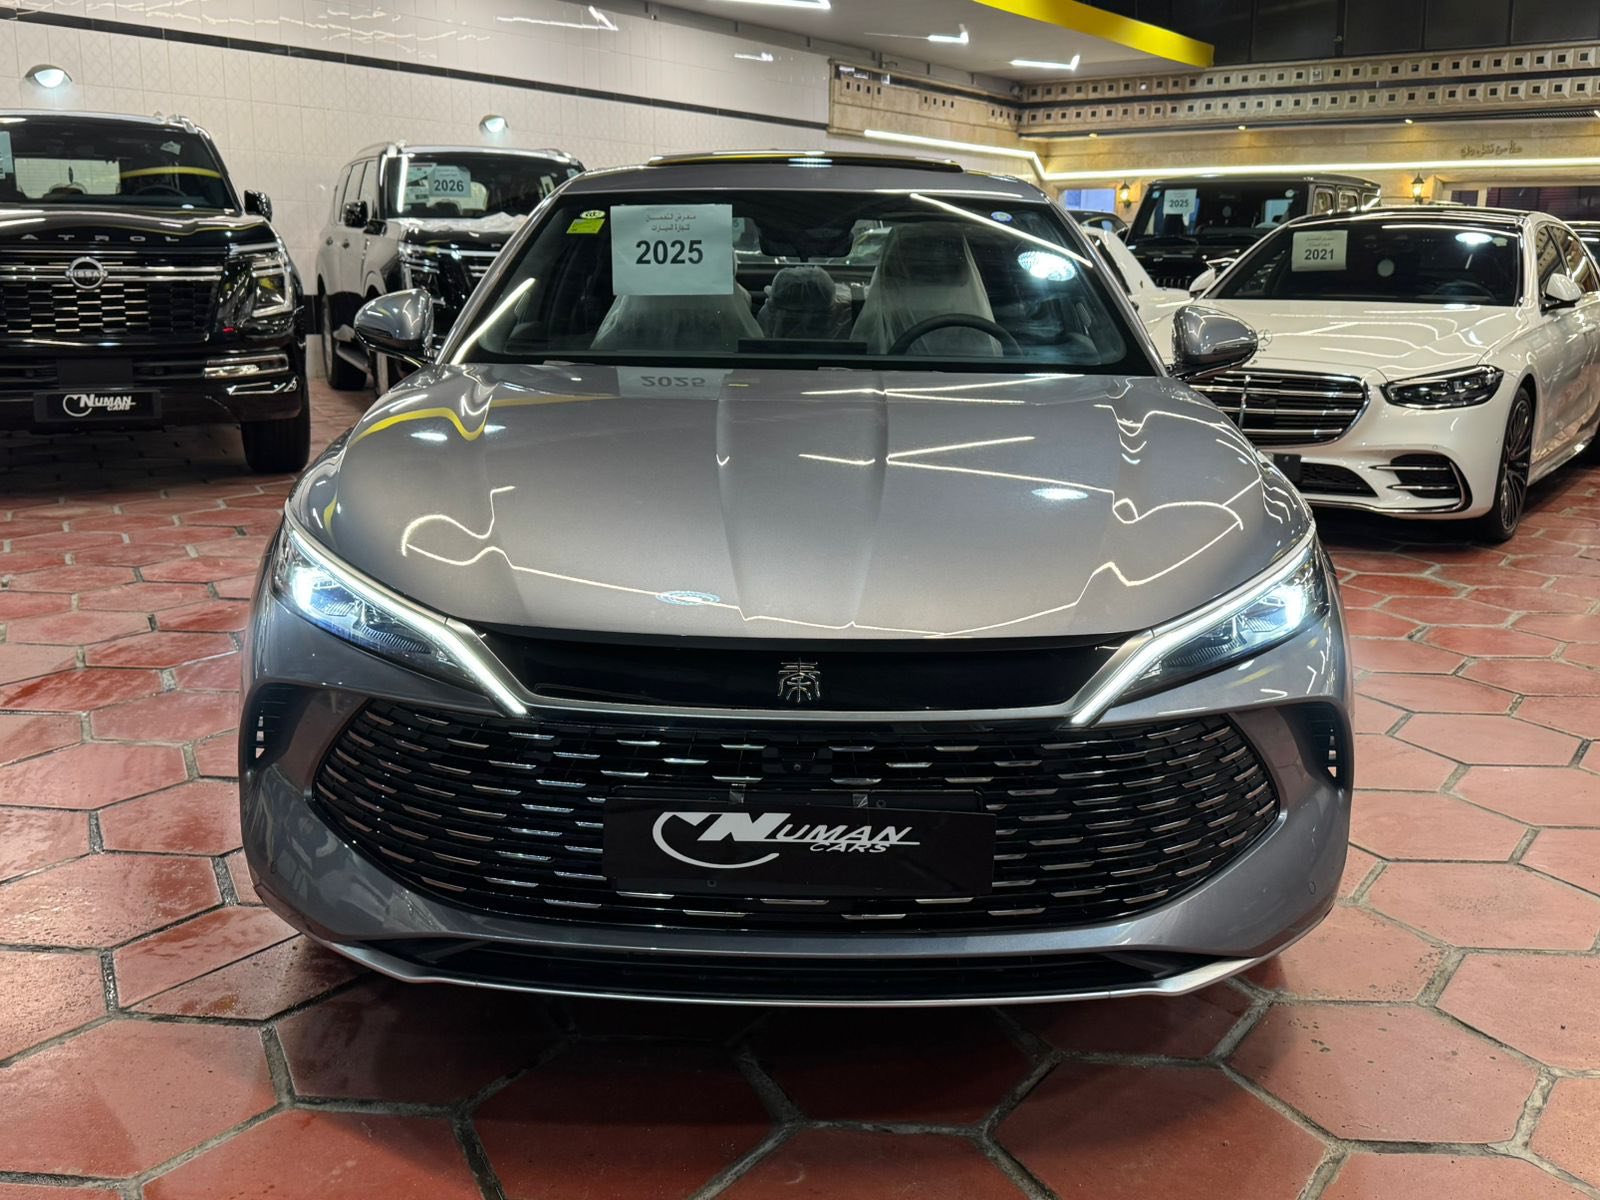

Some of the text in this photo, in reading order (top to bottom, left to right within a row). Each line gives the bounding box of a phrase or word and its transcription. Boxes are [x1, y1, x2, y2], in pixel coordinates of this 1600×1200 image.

[434, 179, 464, 192] 2026
[1169, 199, 1189, 208] 2025
[20, 233, 179, 242] ATROL
[635, 240, 704, 265] 2025
[1304, 248, 1334, 261] 2021
[65, 269, 108, 279] NISSAN
[79, 394, 134, 408] NUMAN
[696, 812, 918, 845] NUMAN
[809, 840, 889, 853] CARS
